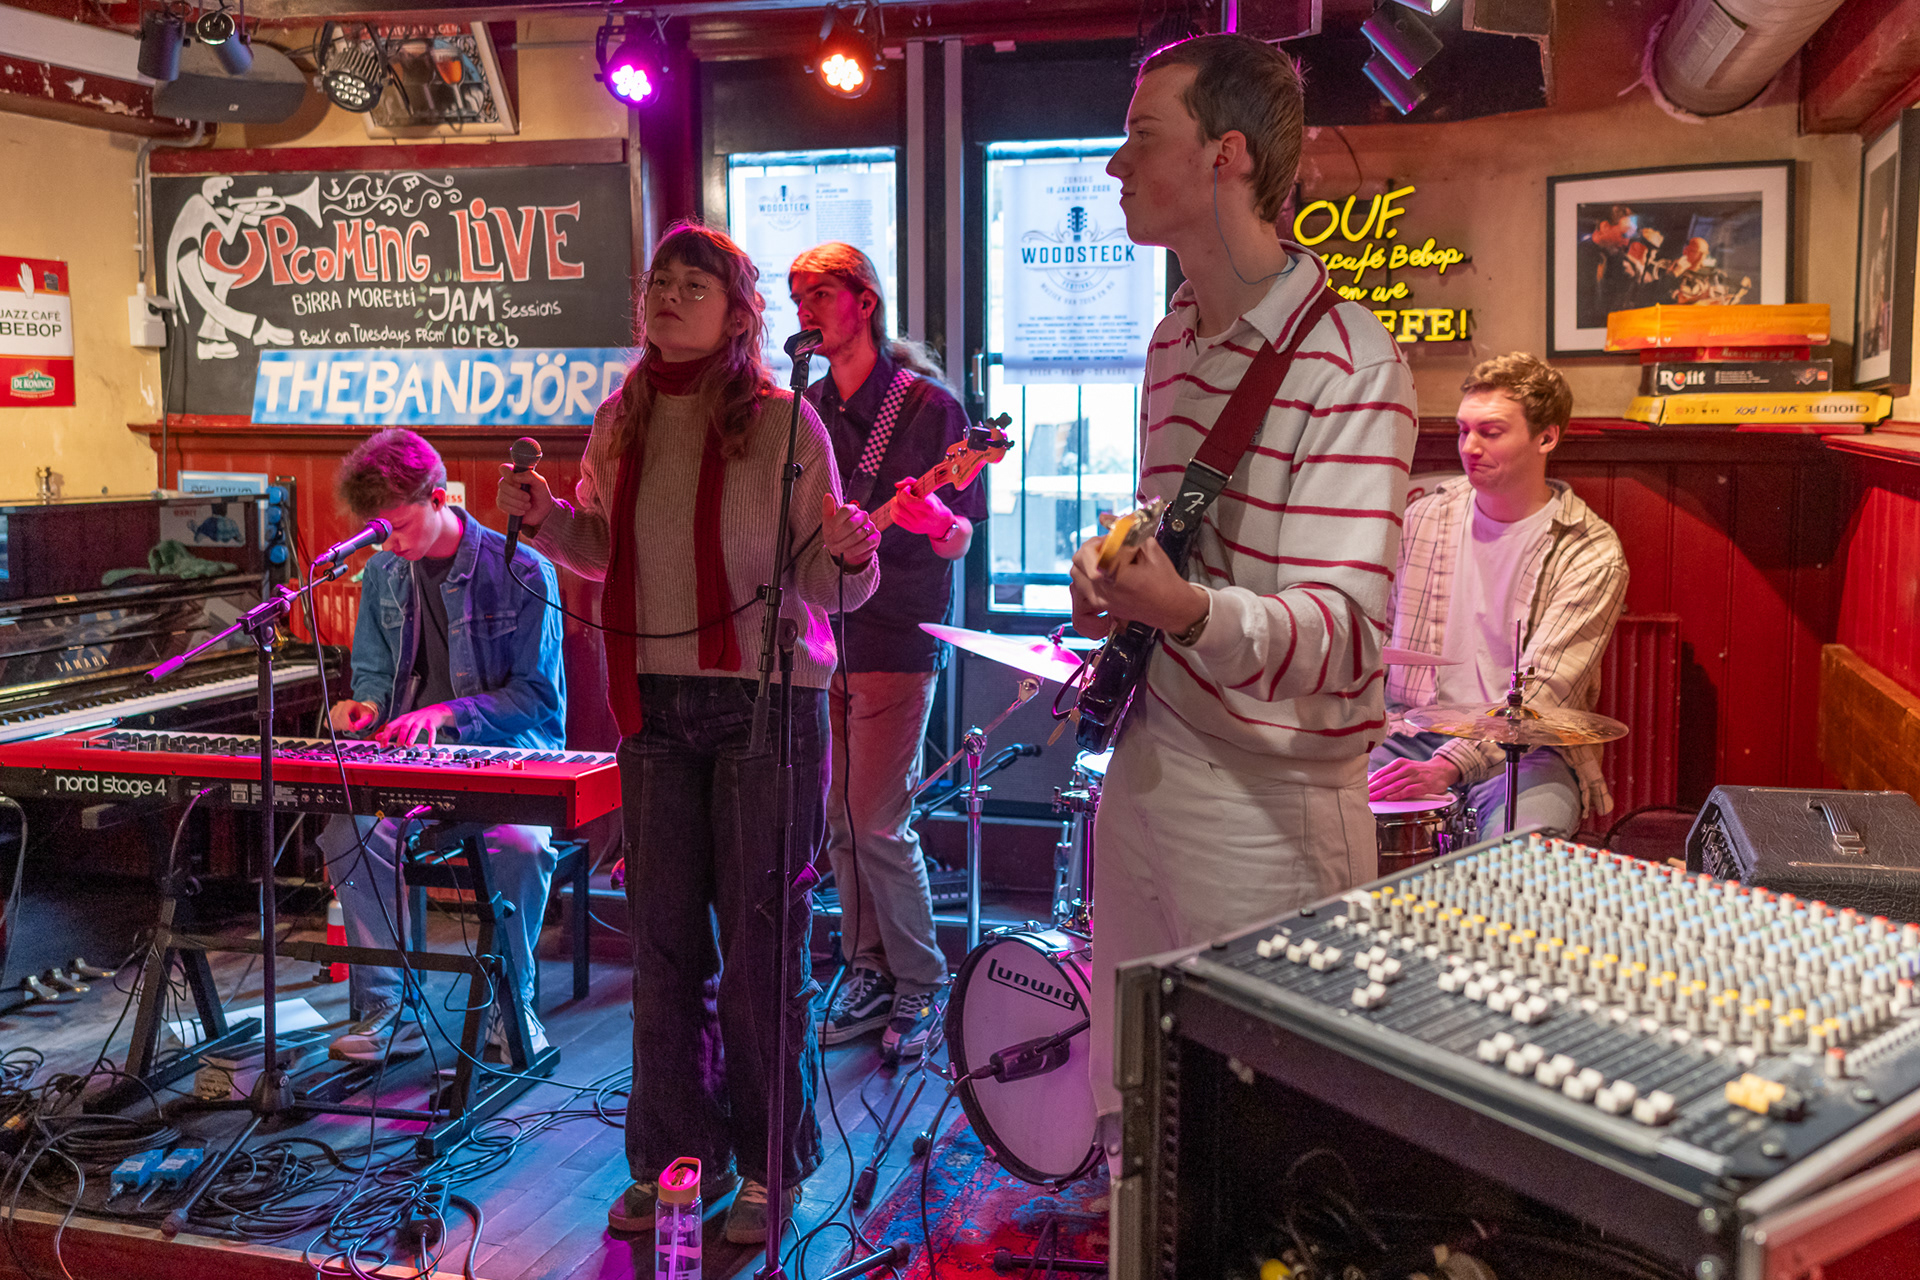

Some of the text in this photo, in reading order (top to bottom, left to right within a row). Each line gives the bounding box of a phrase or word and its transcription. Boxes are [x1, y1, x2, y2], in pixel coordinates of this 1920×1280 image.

[759, 203, 809, 212] WOODSTECK
[1021, 245, 1135, 264] WOODSTECK
[1388, 238, 1464, 274] Bebop
[1371, 281, 1409, 302] we
[429, 286, 495, 322] JAM
[501, 300, 562, 319] Sessions
[0, 309, 61, 322] JAZZ CAFÉ
[0, 322, 62, 337] BEBOP
[335, 331, 350, 342] on
[350, 324, 411, 346] Tuesdays
[452, 328, 470, 345] 10
[476, 327, 519, 348] Feb
[1805, 404, 1870, 414] CHOUFFE
[55, 655, 109, 672] YAMAHA
[55, 775, 167, 798] nord stage 4
